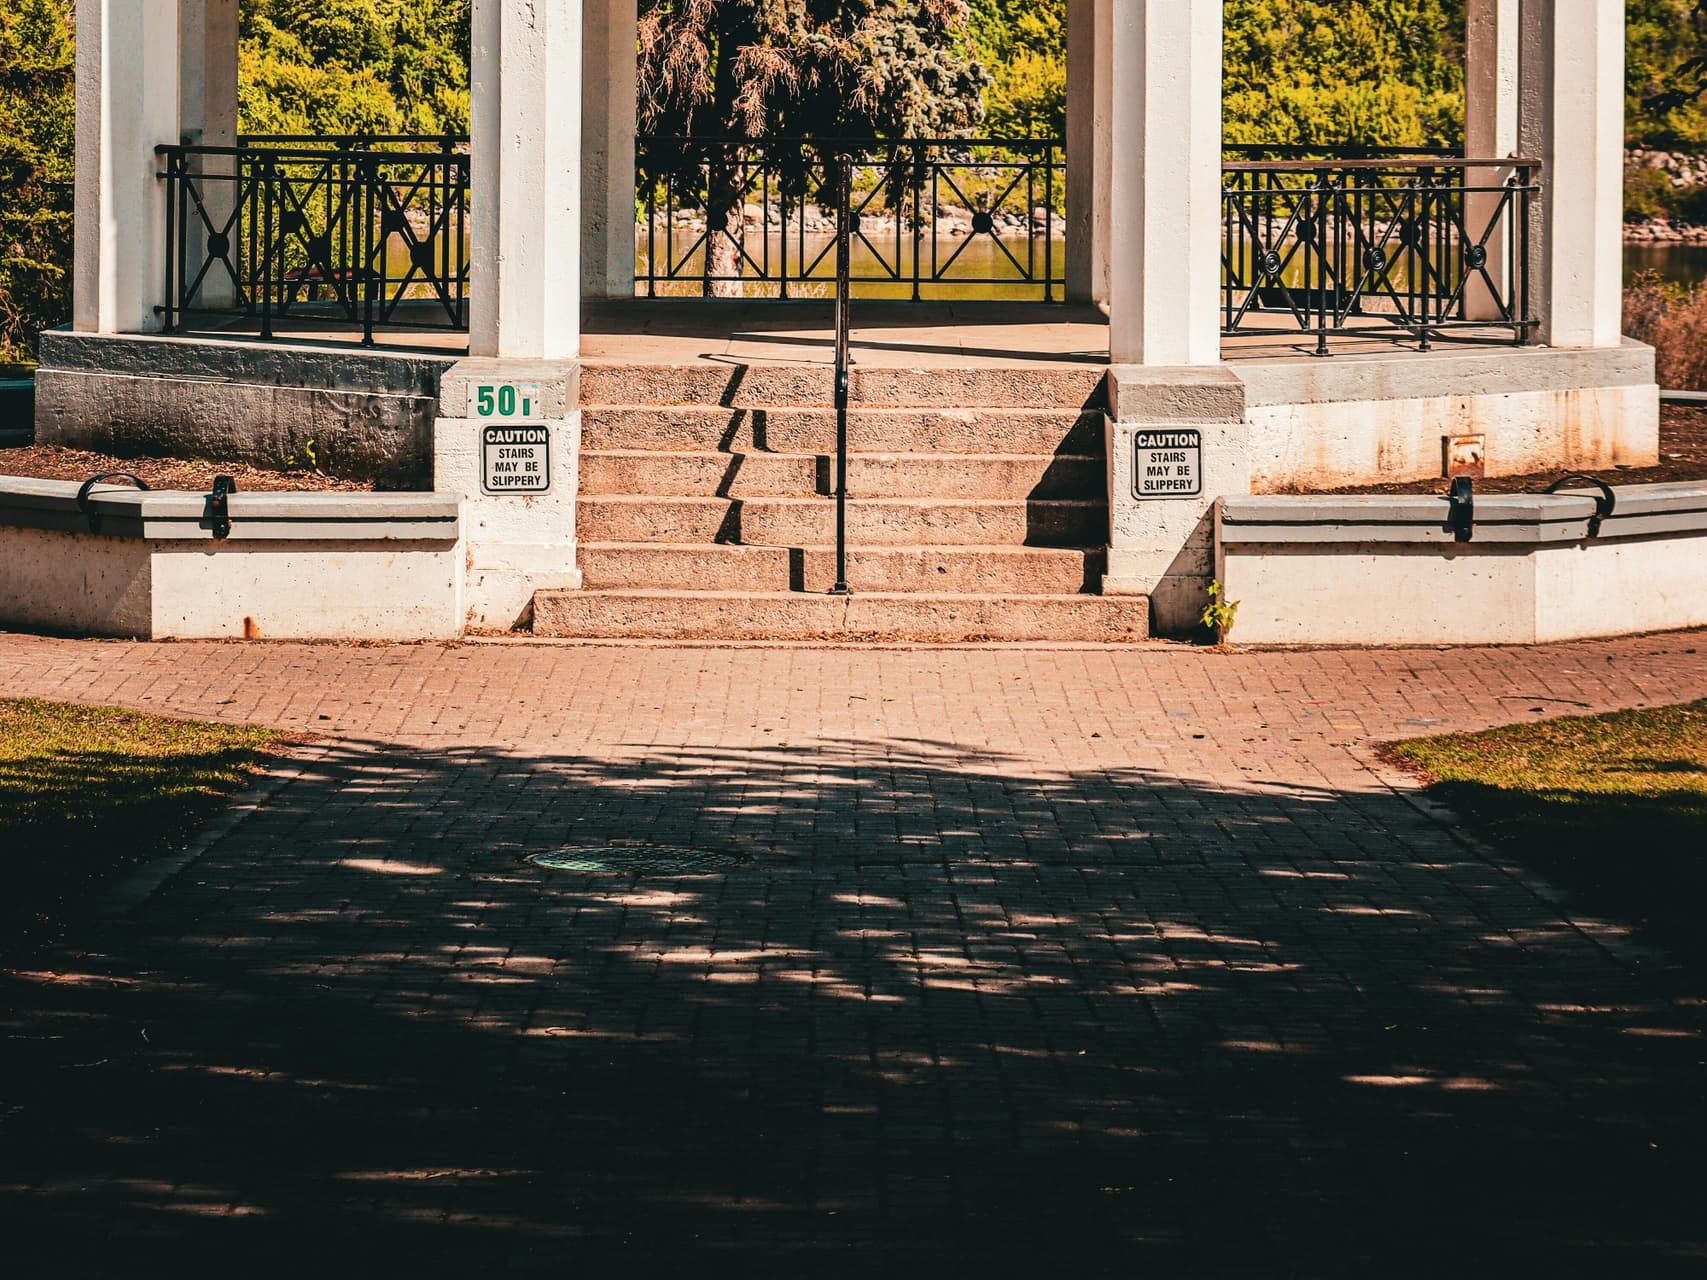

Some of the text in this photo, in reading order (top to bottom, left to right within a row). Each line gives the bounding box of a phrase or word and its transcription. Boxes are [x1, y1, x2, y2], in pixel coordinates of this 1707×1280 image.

[486, 430, 547, 443] CAUTION
[1137, 434, 1198, 447] CAUTION
[498, 448, 535, 459] STAIRS
[1150, 452, 1186, 463] STAIRS
[495, 461, 538, 472] MAY BE
[1146, 465, 1190, 476] MAY BE
[492, 475, 541, 486] SLIPPERY
[1144, 479, 1193, 490] SLIPPERY
